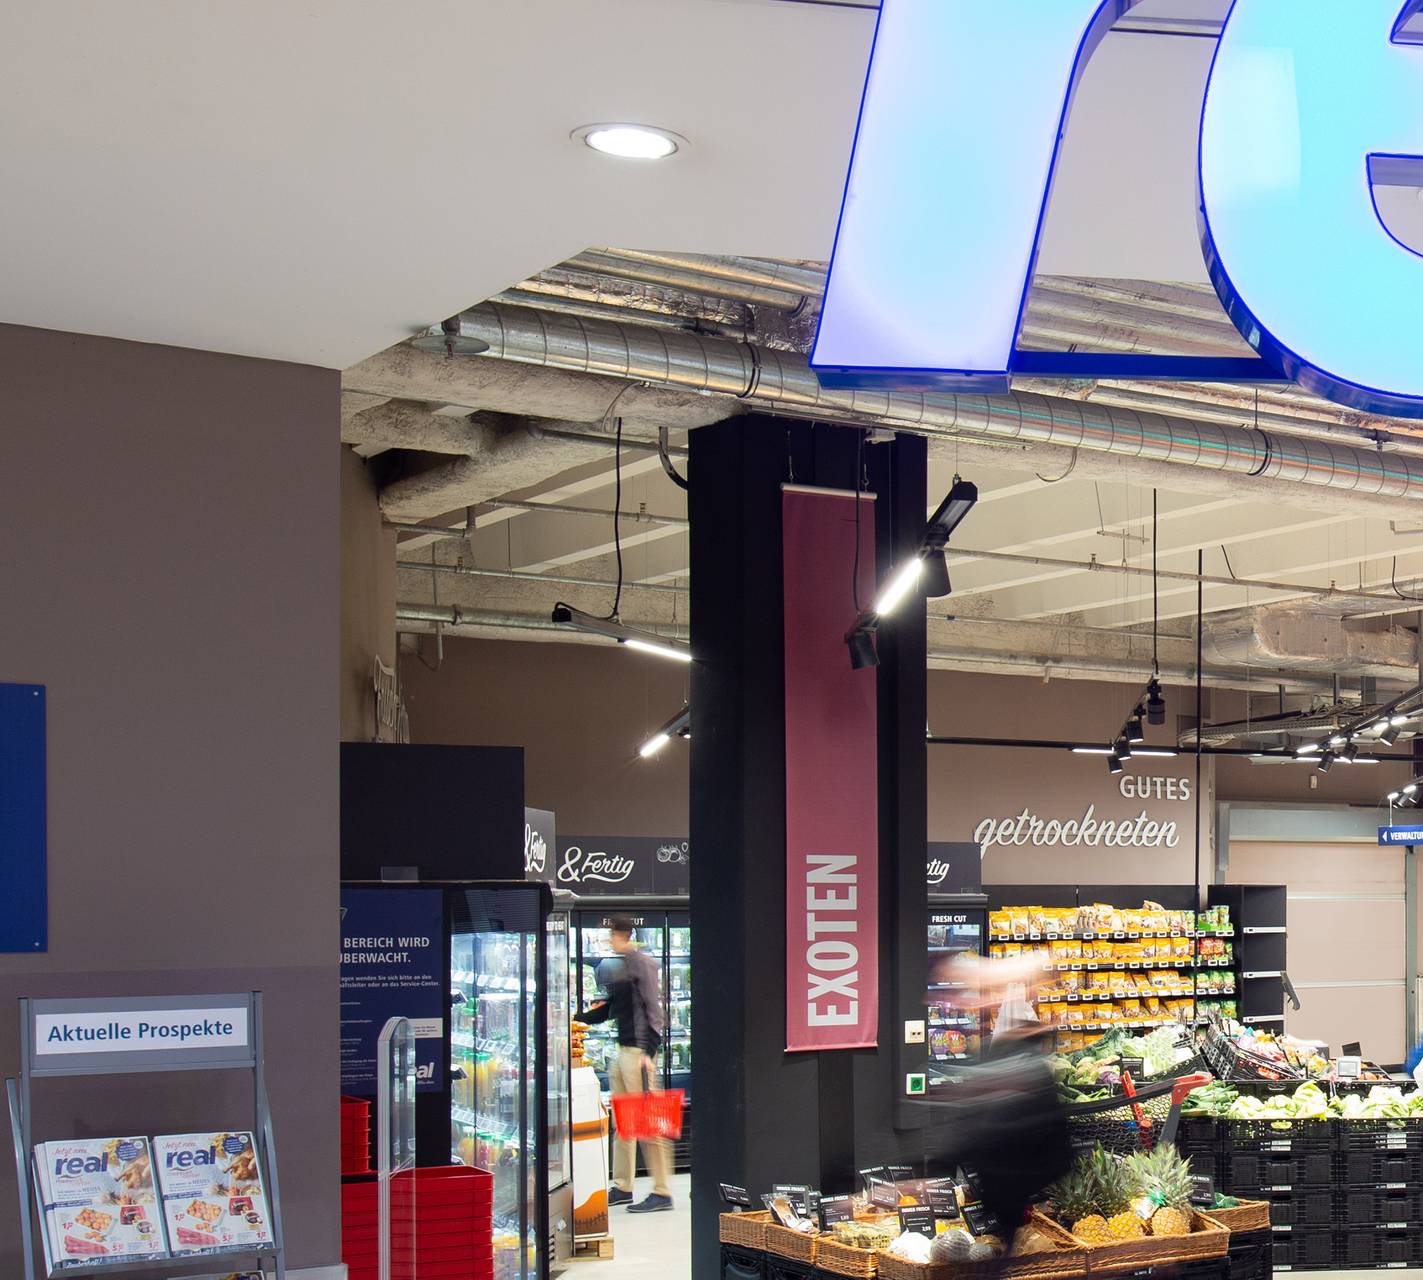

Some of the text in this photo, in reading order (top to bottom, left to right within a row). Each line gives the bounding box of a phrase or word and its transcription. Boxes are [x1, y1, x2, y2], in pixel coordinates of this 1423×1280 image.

[1119, 775, 1191, 800] GUTES
[973, 803, 1180, 860] getrockneten
[581, 852, 635, 883] Fertig
[932, 915, 967, 923] FRESH CUT
[344, 937, 430, 948] BEREICH WIRD
[806, 854, 858, 1027] EXOTEN
[48, 1019, 233, 1042] Aktuelle Prospekte
[55, 1151, 109, 1176] real
[165, 1145, 217, 1168] real
